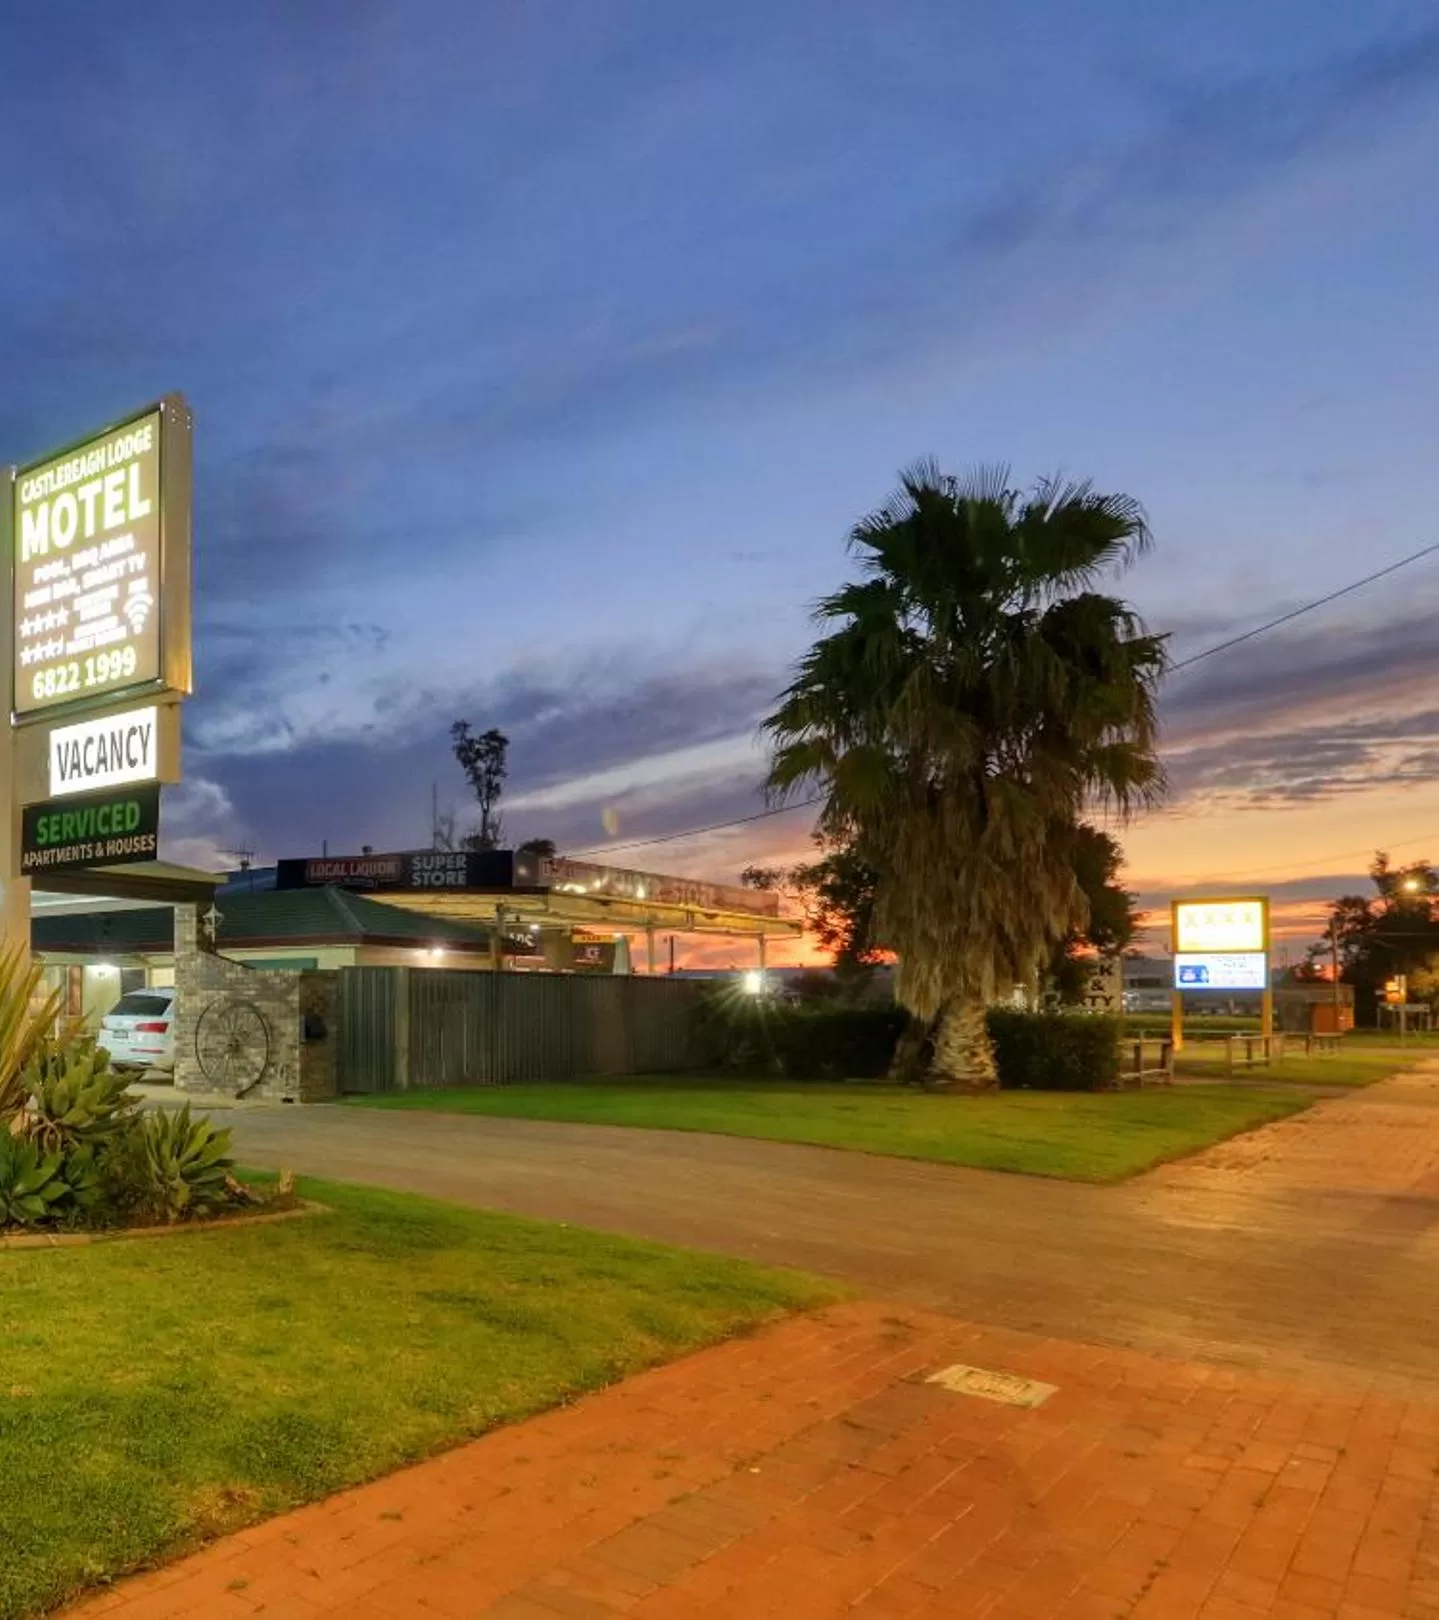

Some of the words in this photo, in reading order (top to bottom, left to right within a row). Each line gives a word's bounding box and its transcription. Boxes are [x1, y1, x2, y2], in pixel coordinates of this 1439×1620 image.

[21, 450, 106, 504] CASTLEREAGH
[107, 424, 153, 465] LODGE
[21, 461, 151, 563] MOTEL
[32, 661, 81, 700] 6822
[84, 645, 137, 687] 1999
[56, 722, 152, 782] VACANCY
[36, 800, 141, 845] SERVICED
[22, 844, 93, 867] APARTMENTS
[95, 842, 105, 857] &
[106, 833, 156, 857] HOUSES
[310, 861, 348, 877] LOCAL
[349, 859, 395, 876] LIQUOR
[411, 854, 467, 870] SUPER
[411, 870, 467, 887] STORE
